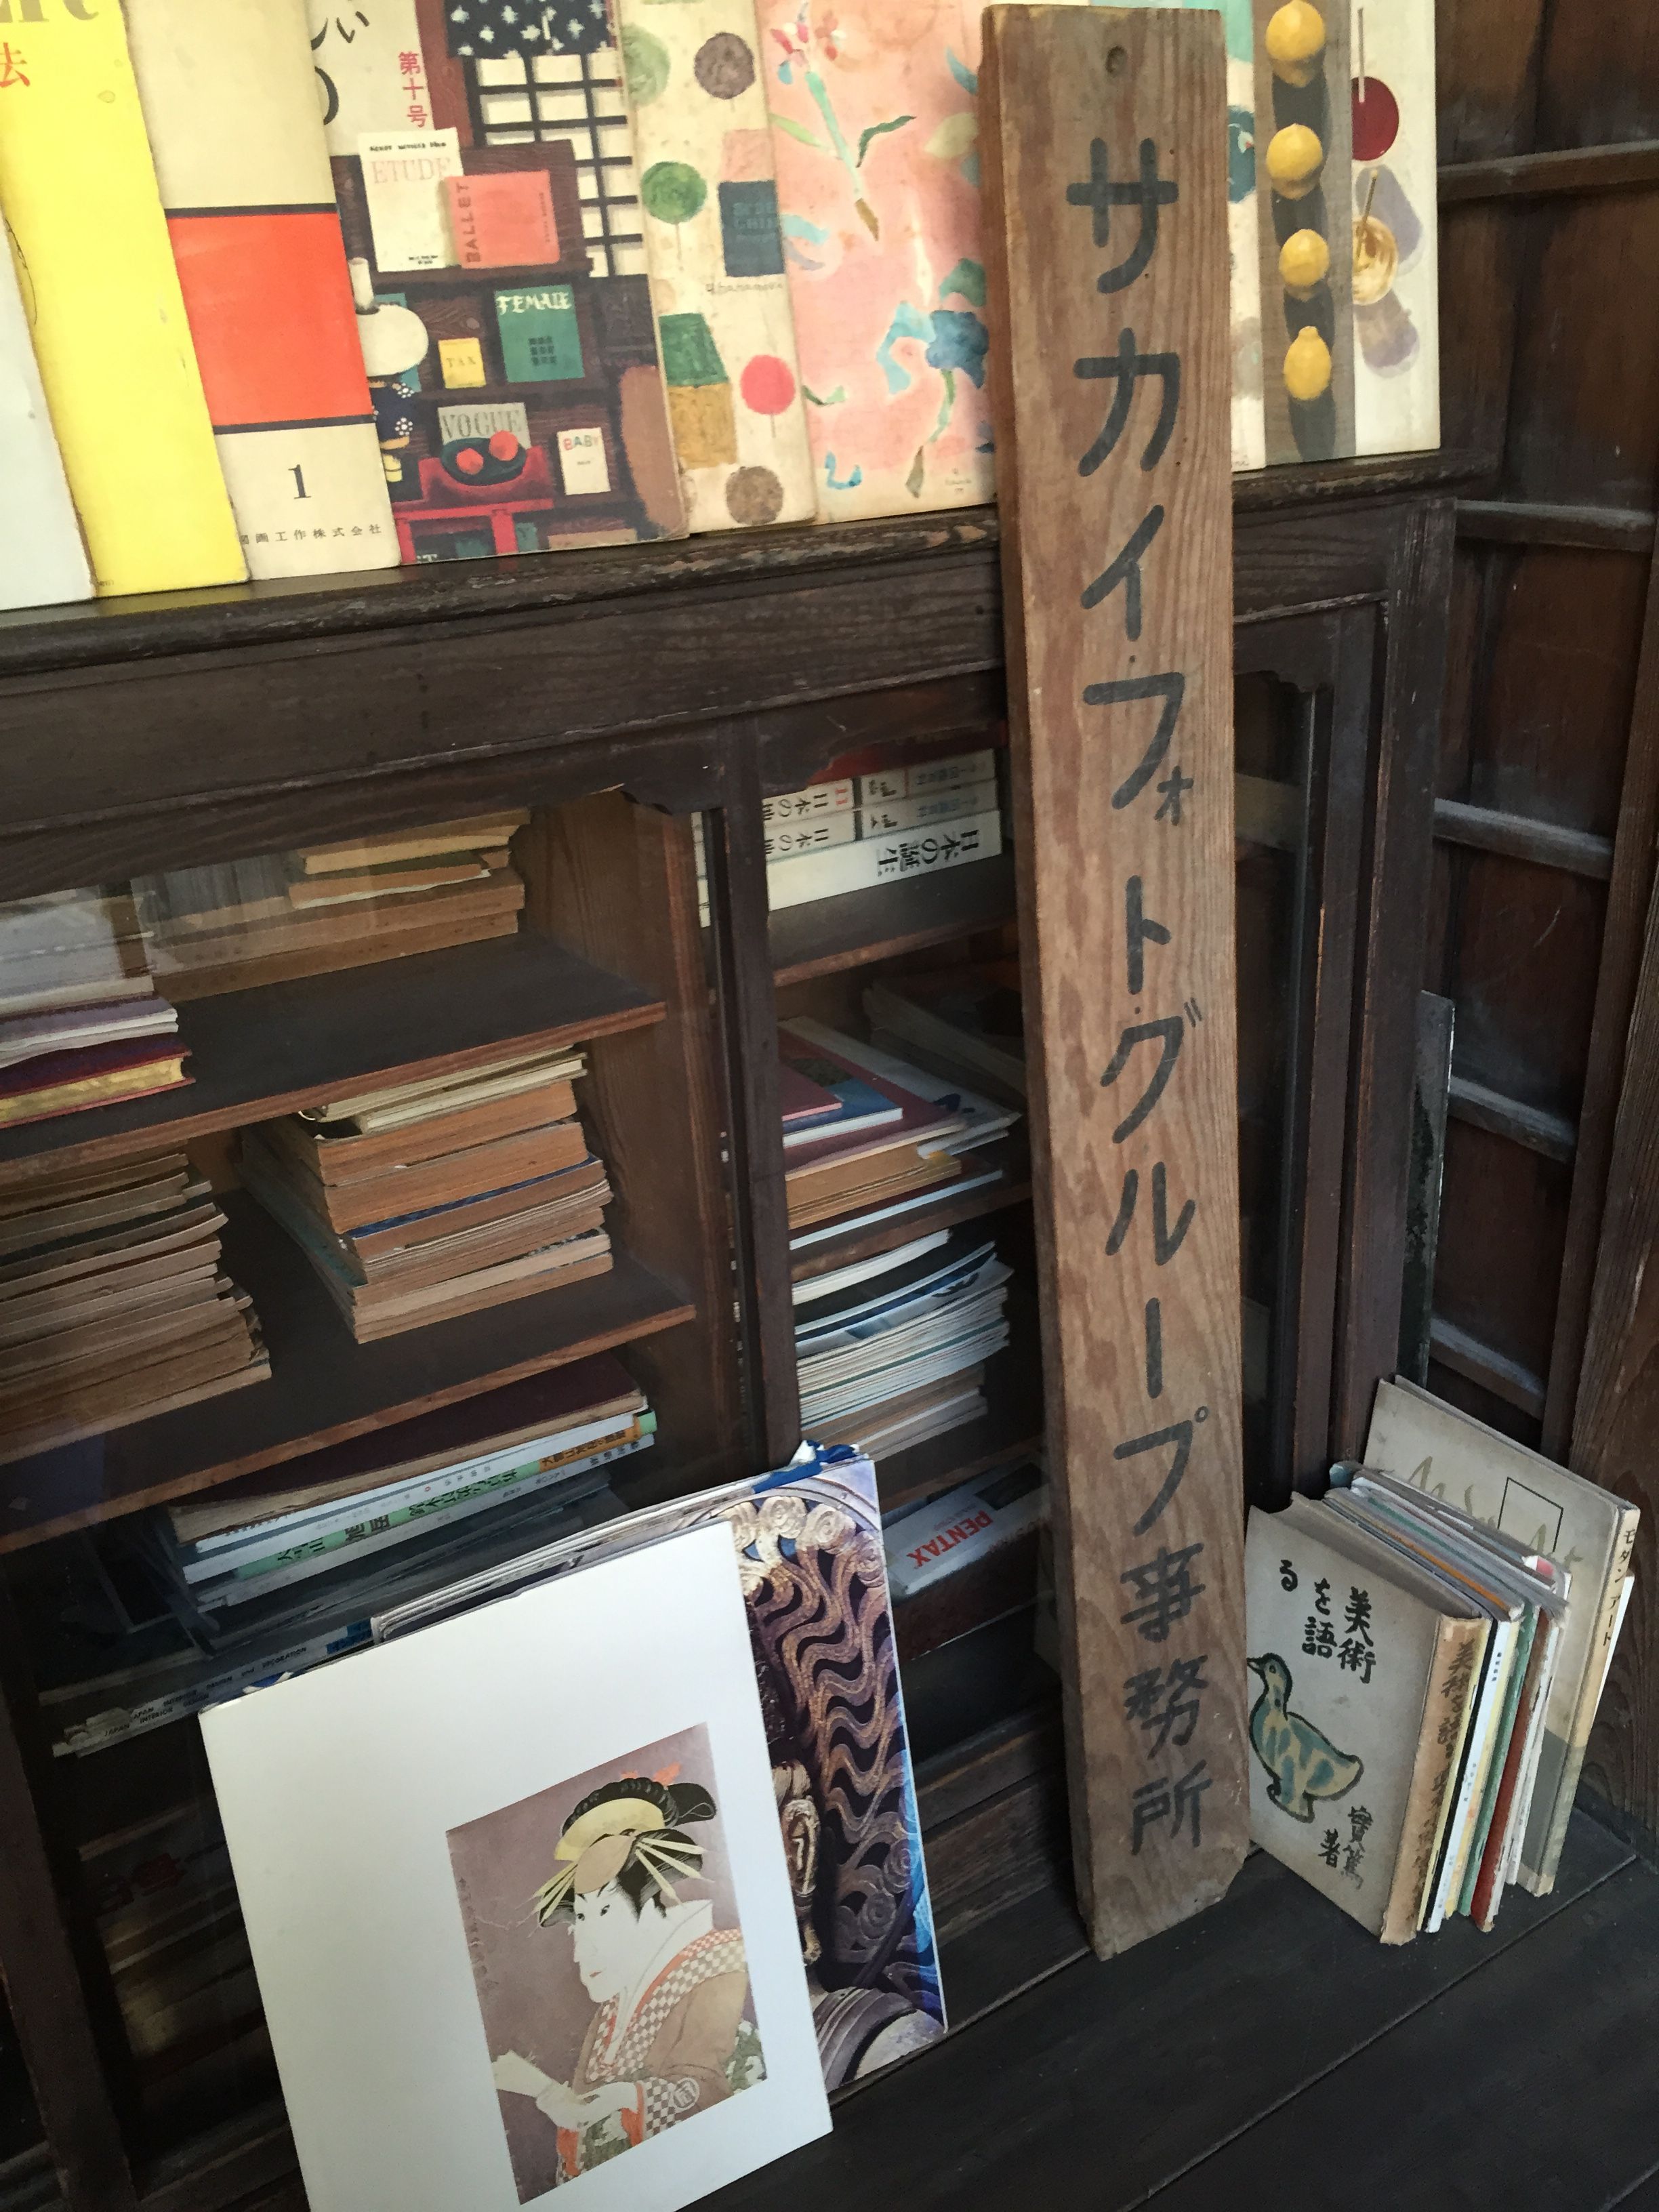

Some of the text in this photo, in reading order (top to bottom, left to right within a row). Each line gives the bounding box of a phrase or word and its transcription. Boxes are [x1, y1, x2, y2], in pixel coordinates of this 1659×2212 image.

[398, 51, 428, 127] 第十号
[371, 157, 451, 184] ETUDE
[456, 182, 481, 263] BALLET
[441, 409, 523, 439] VOGUE
[287, 464, 312, 499] 1
[1065, 138, 1212, 1857] サカイフォトグループ事務所
[906, 1510, 994, 1569] PENTAX
[1337, 1586, 1377, 1685] 美術
